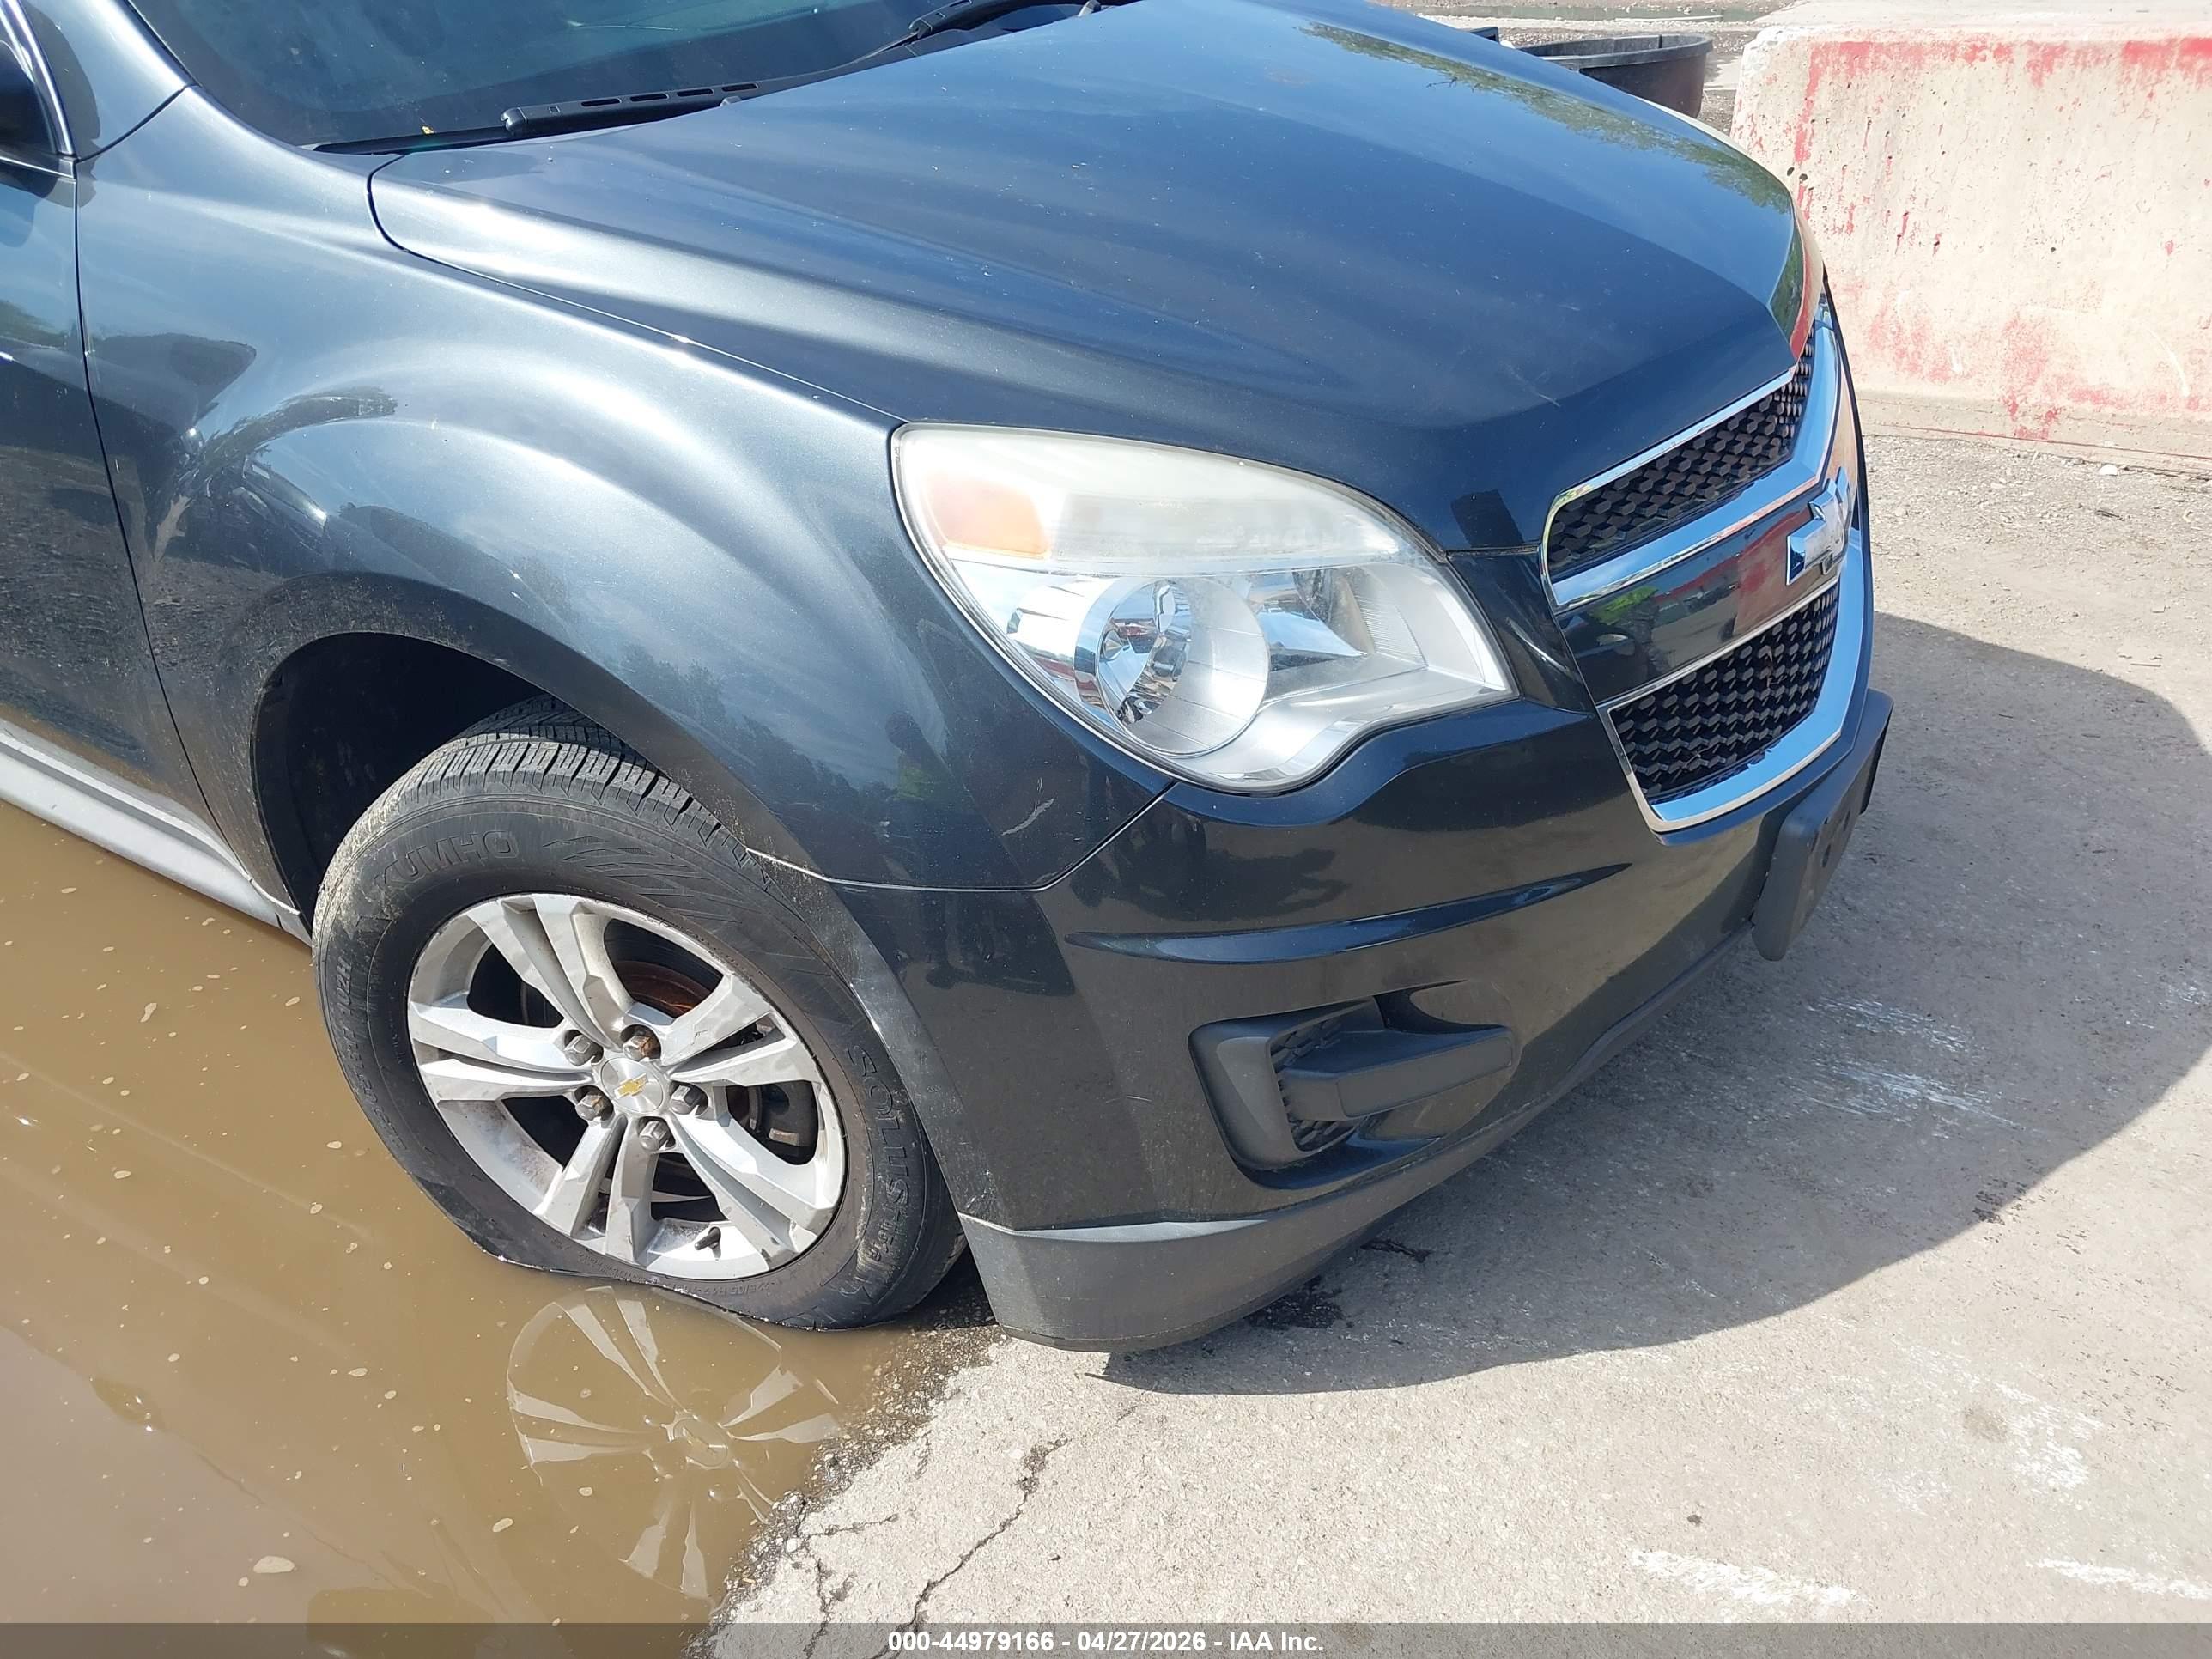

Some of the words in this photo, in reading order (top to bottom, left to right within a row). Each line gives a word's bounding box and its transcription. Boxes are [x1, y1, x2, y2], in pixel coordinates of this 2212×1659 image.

[374, 830, 520, 886] KUMHO
[336, 955, 353, 1016] 102H
[846, 1044, 908, 1204] SOLUS
